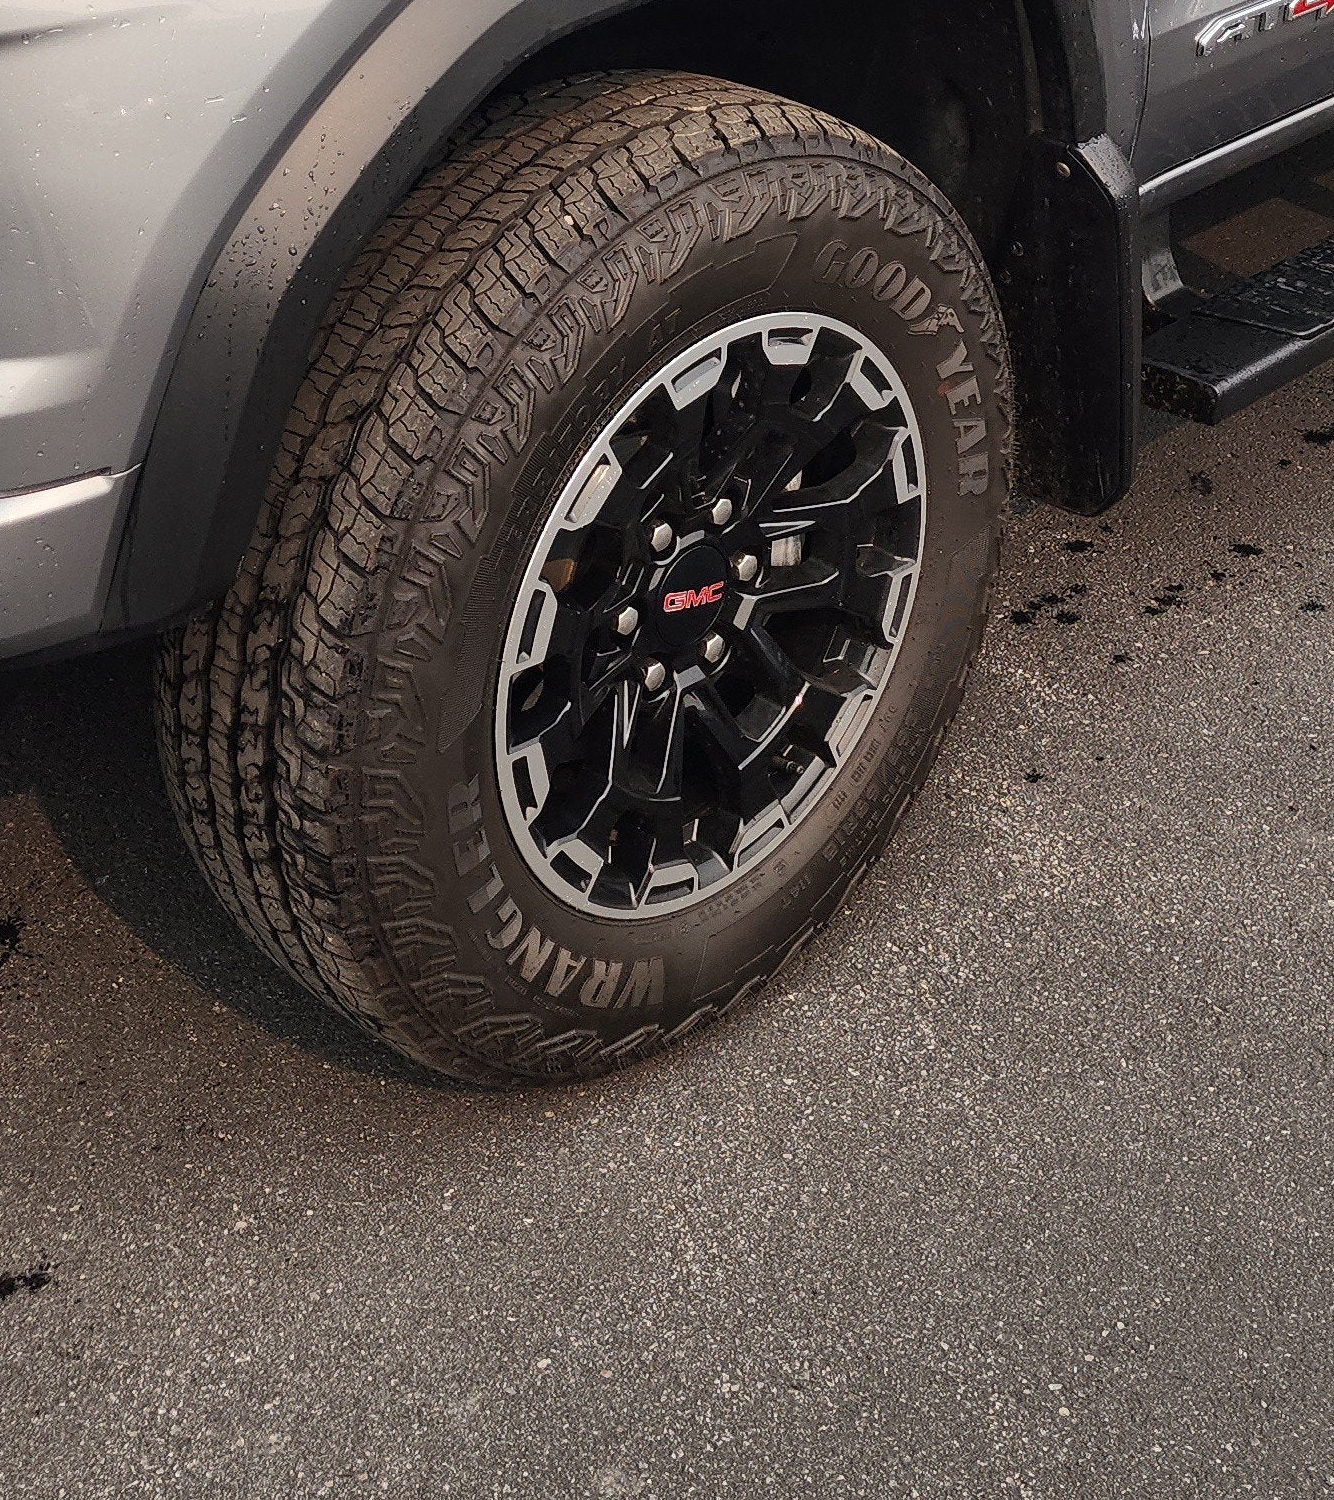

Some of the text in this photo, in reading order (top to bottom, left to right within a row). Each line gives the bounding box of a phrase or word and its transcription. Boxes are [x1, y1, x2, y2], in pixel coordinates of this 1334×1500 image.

[813, 239, 990, 497] GOODYEAR
[663, 581, 724, 613] GMC
[446, 773, 665, 1010] WRANGLER
